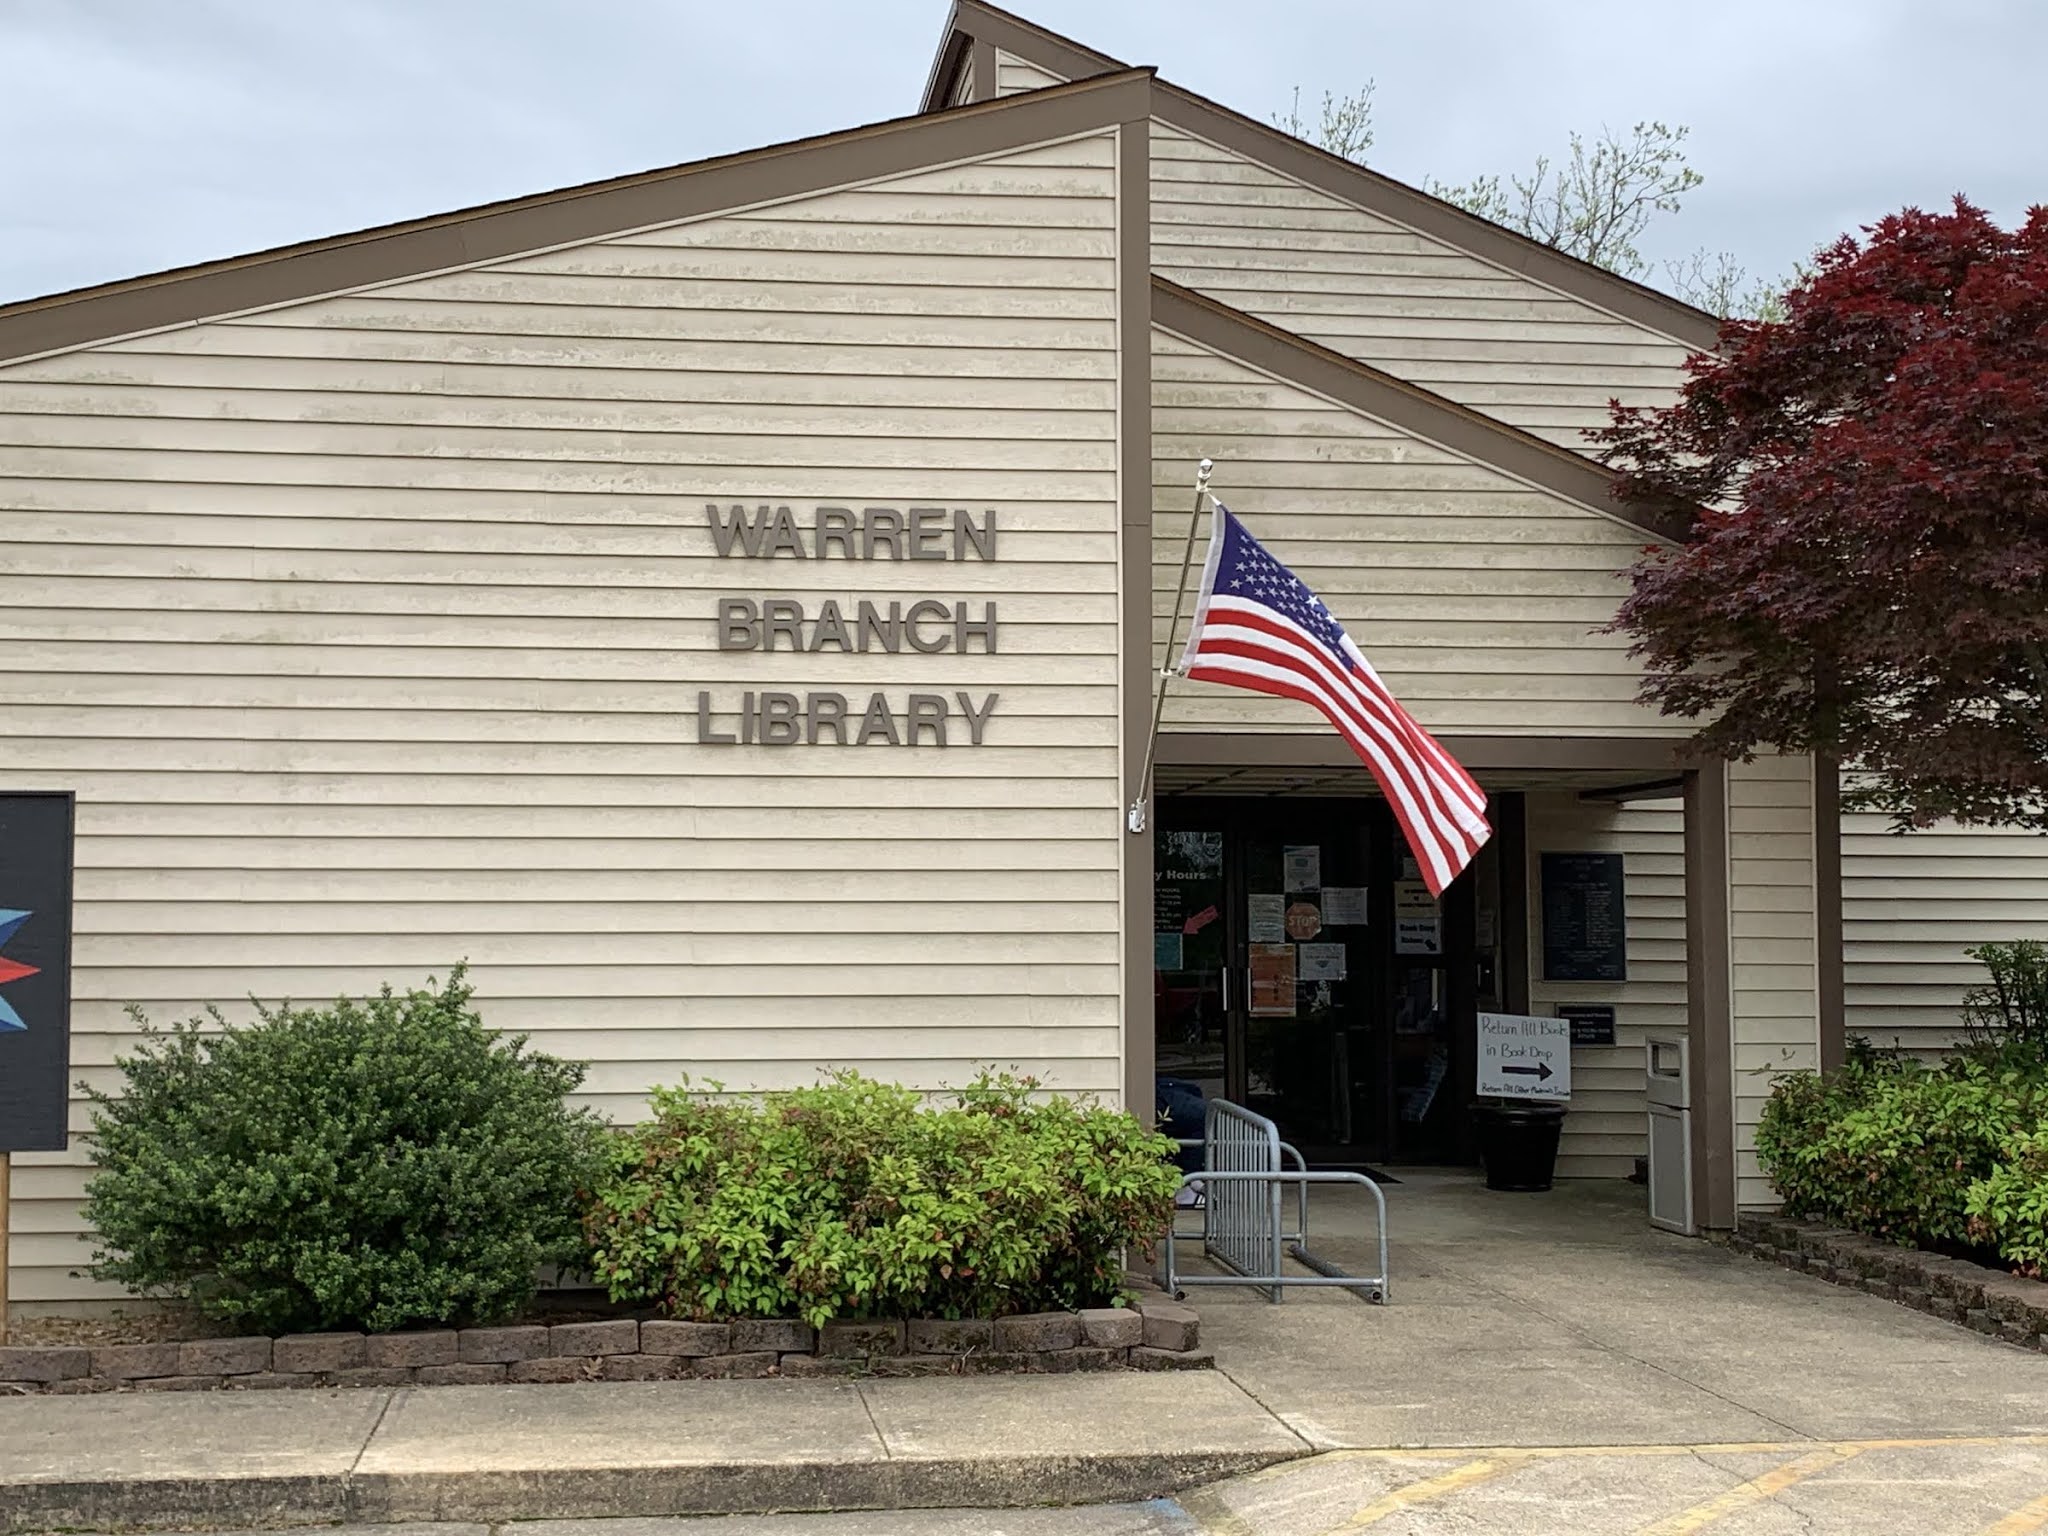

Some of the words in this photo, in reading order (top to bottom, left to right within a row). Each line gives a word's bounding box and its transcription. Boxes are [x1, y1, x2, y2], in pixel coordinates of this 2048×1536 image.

[705, 504, 997, 562] WARREN
[718, 598, 997, 655] BRANCH
[698, 691, 1000, 747] LIBRARY
[1166, 870, 1207, 880] Hours
[1288, 916, 1318, 926] STOP
[1482, 1015, 1517, 1035] Return
[1521, 1020, 1536, 1036] All
[1486, 1044, 1496, 1057] in
[1501, 1043, 1525, 1058] Book
[1529, 1046, 1553, 1062] Drop
